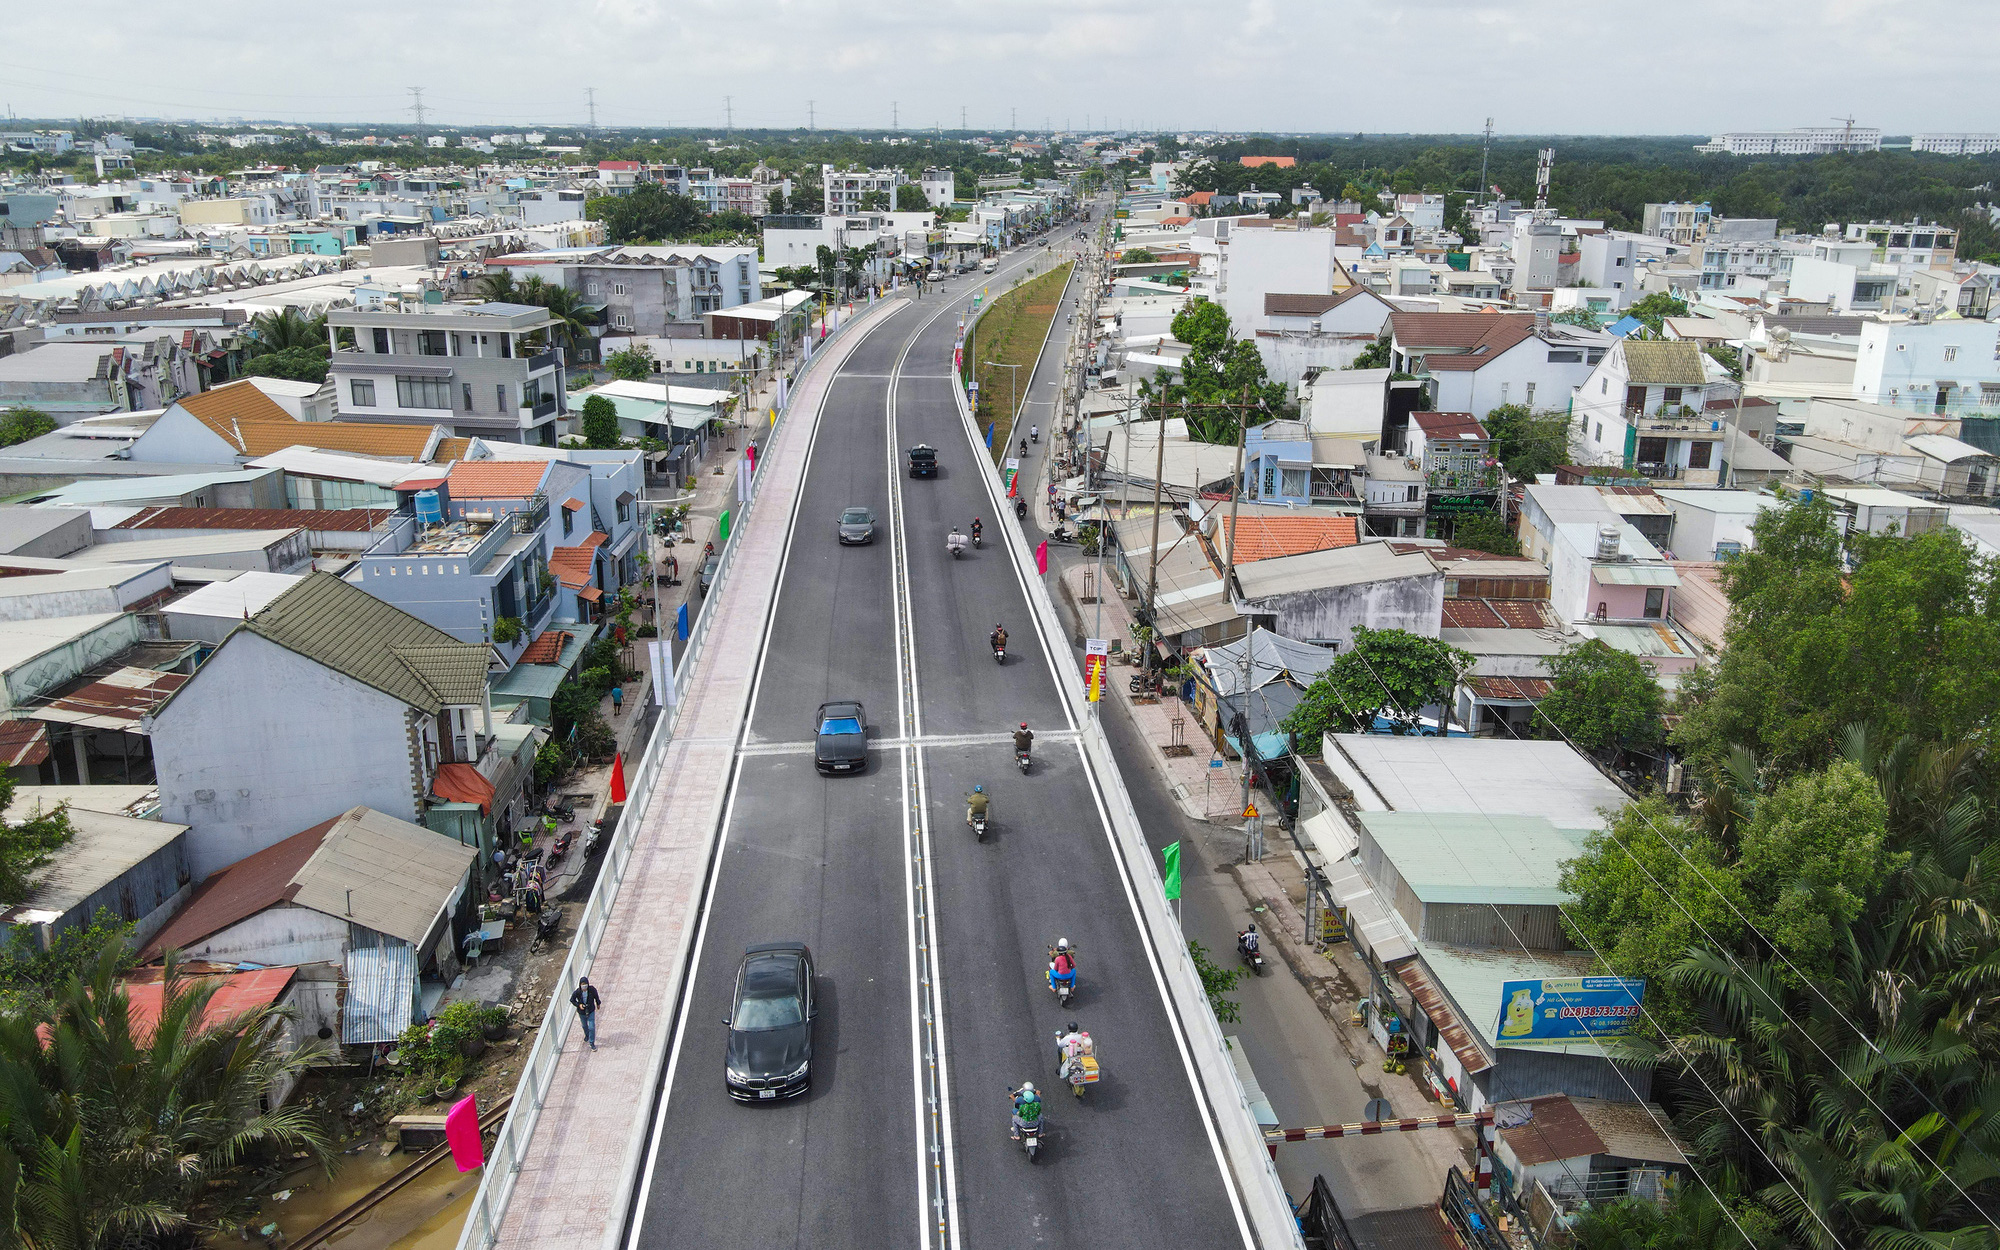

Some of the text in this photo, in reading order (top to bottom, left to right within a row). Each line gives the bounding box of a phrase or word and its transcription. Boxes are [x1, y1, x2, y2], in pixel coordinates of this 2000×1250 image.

[1439, 495, 1471, 503] Oanh
[1326, 910, 1344, 918] HT
[1560, 1005, 1639, 1019] (028)38.73.73.73
